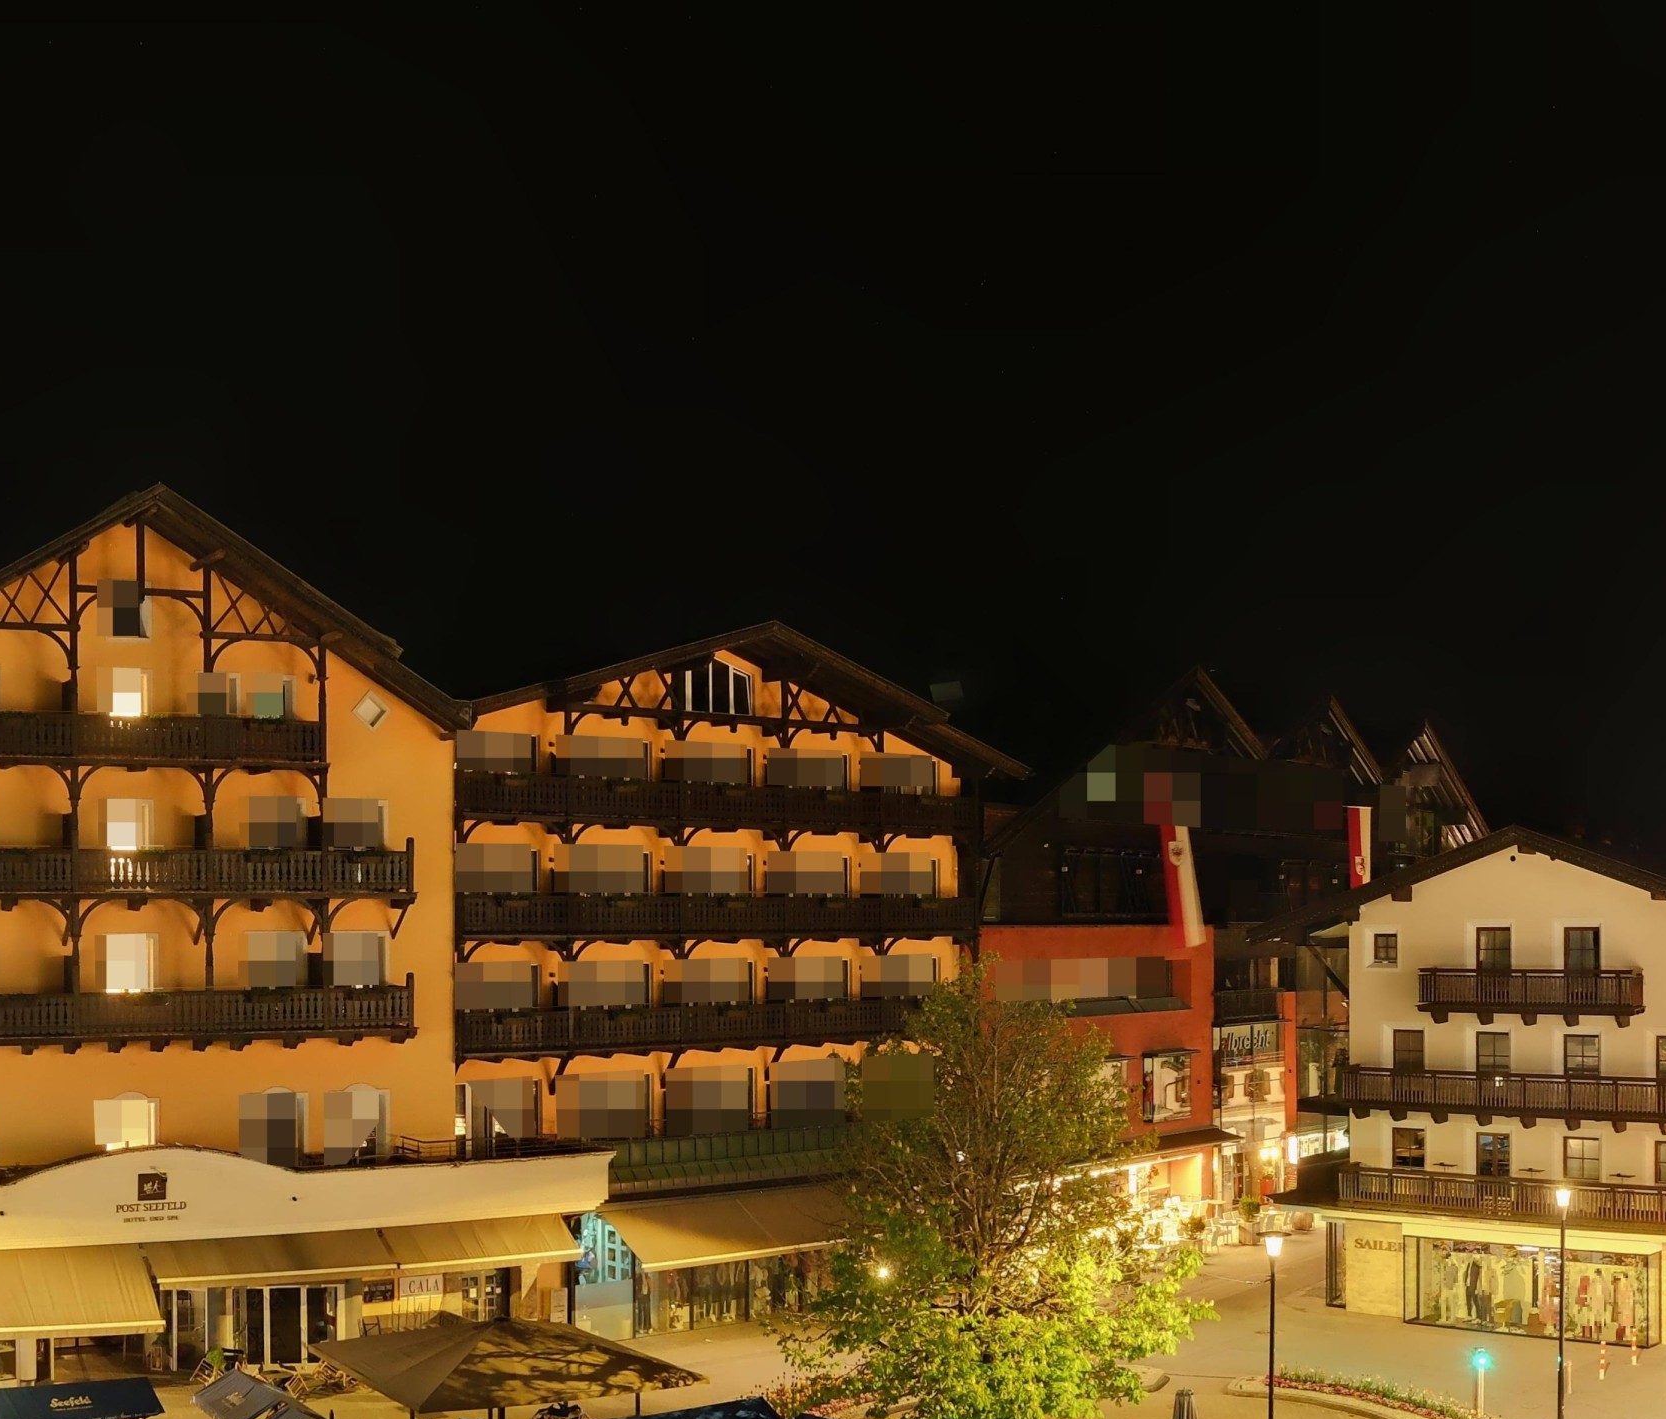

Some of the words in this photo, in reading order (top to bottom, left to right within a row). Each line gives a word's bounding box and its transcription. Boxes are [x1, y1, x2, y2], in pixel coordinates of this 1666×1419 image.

[115, 1202, 142, 1213] POST
[143, 1200, 187, 1212] SEEFELD
[408, 1278, 440, 1294] CALA
[49, 1395, 93, 1410] Seefeld
